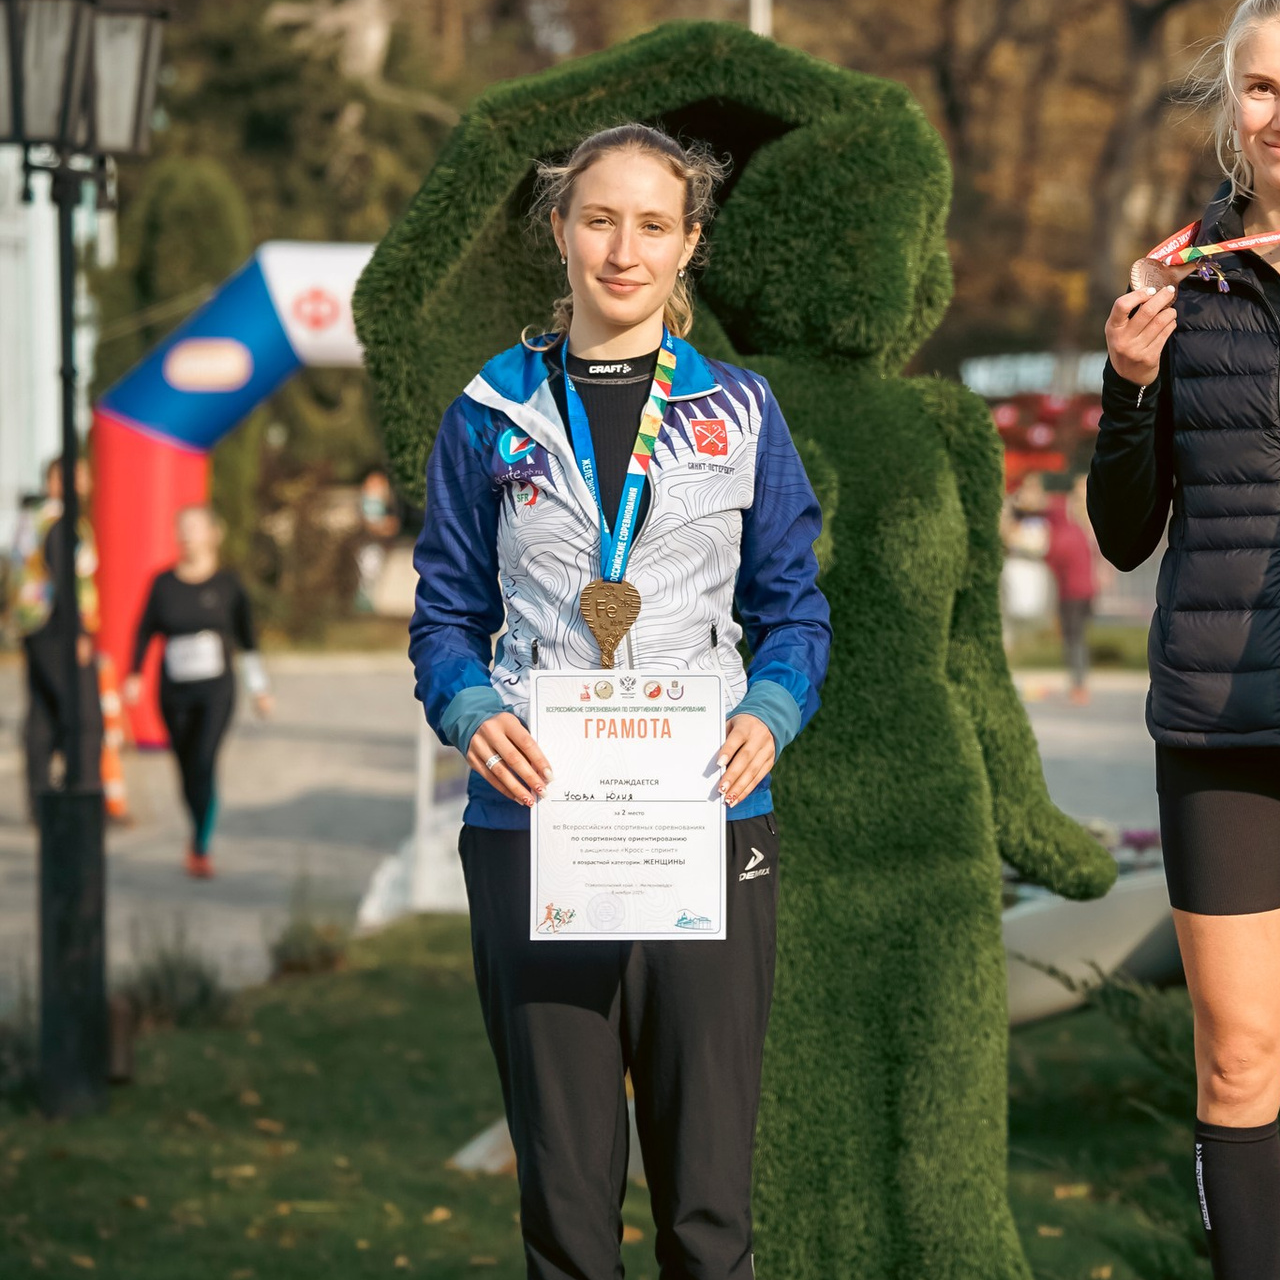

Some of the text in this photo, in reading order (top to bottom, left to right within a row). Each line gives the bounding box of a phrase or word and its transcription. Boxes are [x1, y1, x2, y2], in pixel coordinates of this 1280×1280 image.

[589, 364, 623, 374] CRAFT
[517, 493, 529, 503] SFR
[619, 487, 638, 541] СОРЕВНОВАНИЯ
[595, 599, 618, 618] Fe
[584, 718, 672, 739] ГРАМОТА
[738, 867, 771, 882] DEMIX
